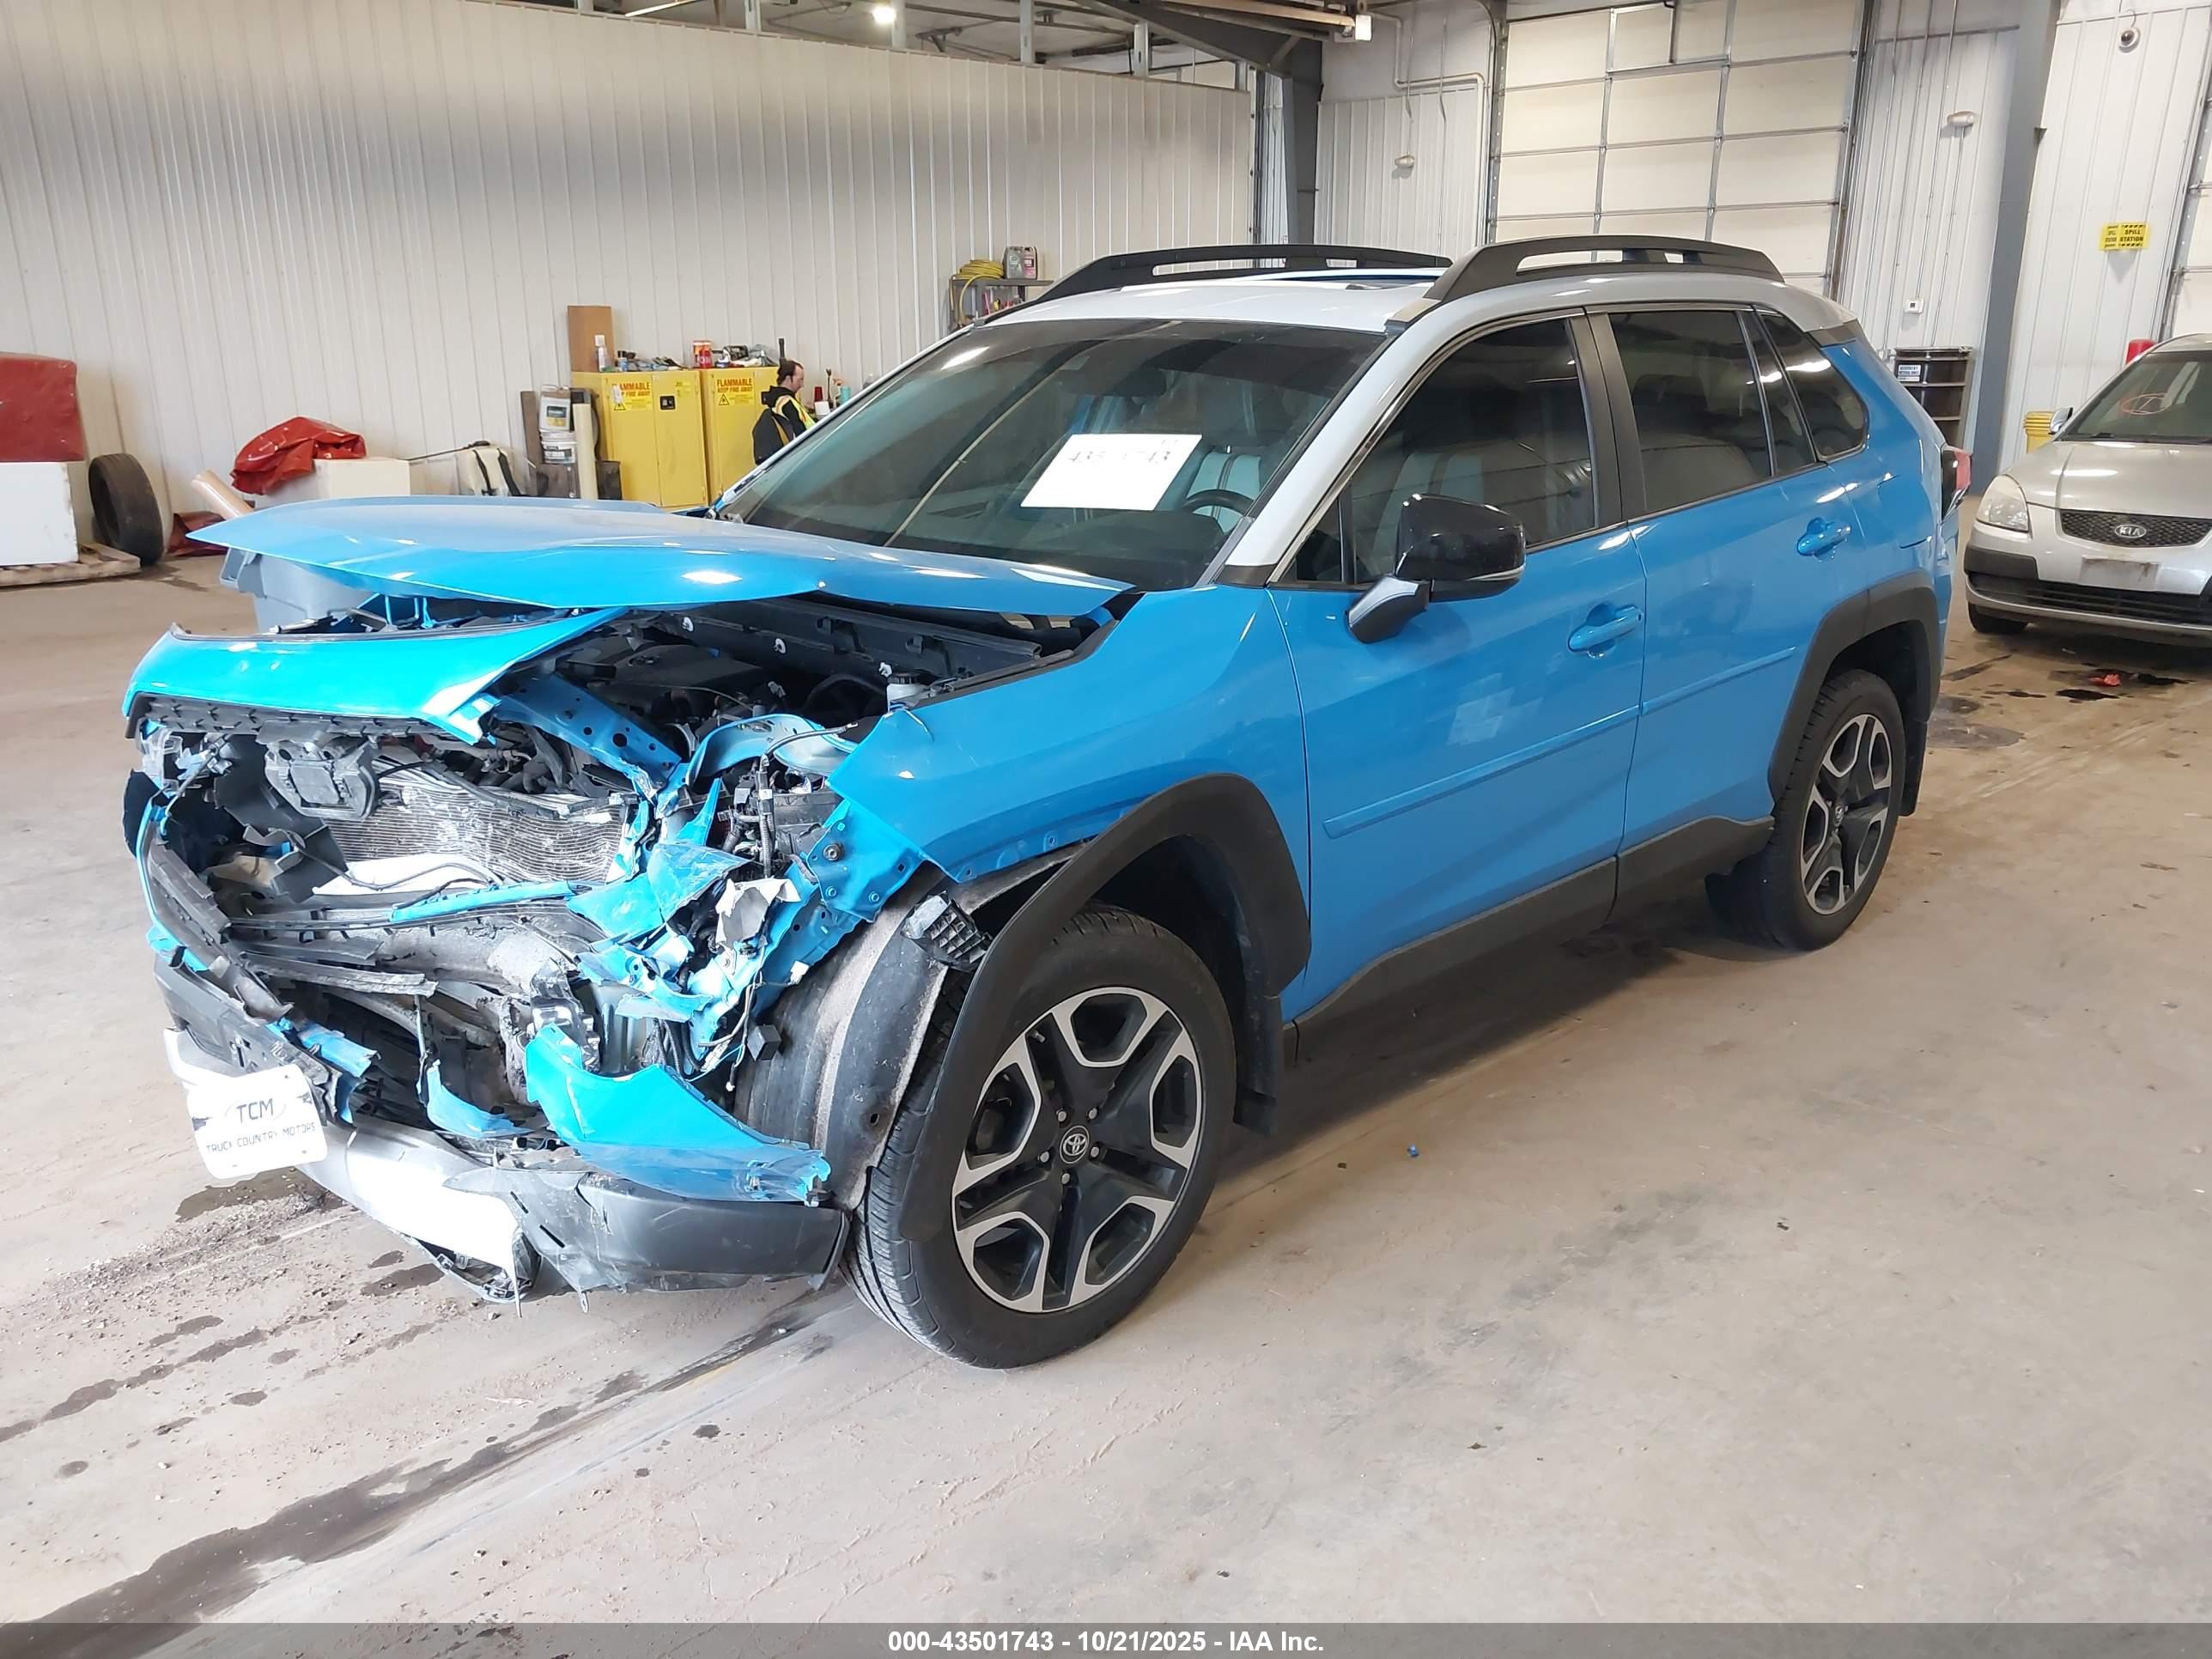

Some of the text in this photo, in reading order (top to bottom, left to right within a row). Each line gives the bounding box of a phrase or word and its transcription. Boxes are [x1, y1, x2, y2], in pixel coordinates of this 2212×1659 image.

[716, 378, 752, 386] FLAMMABLE
[2119, 526, 2141, 536] KIA
[236, 1097, 275, 1124] TCM
